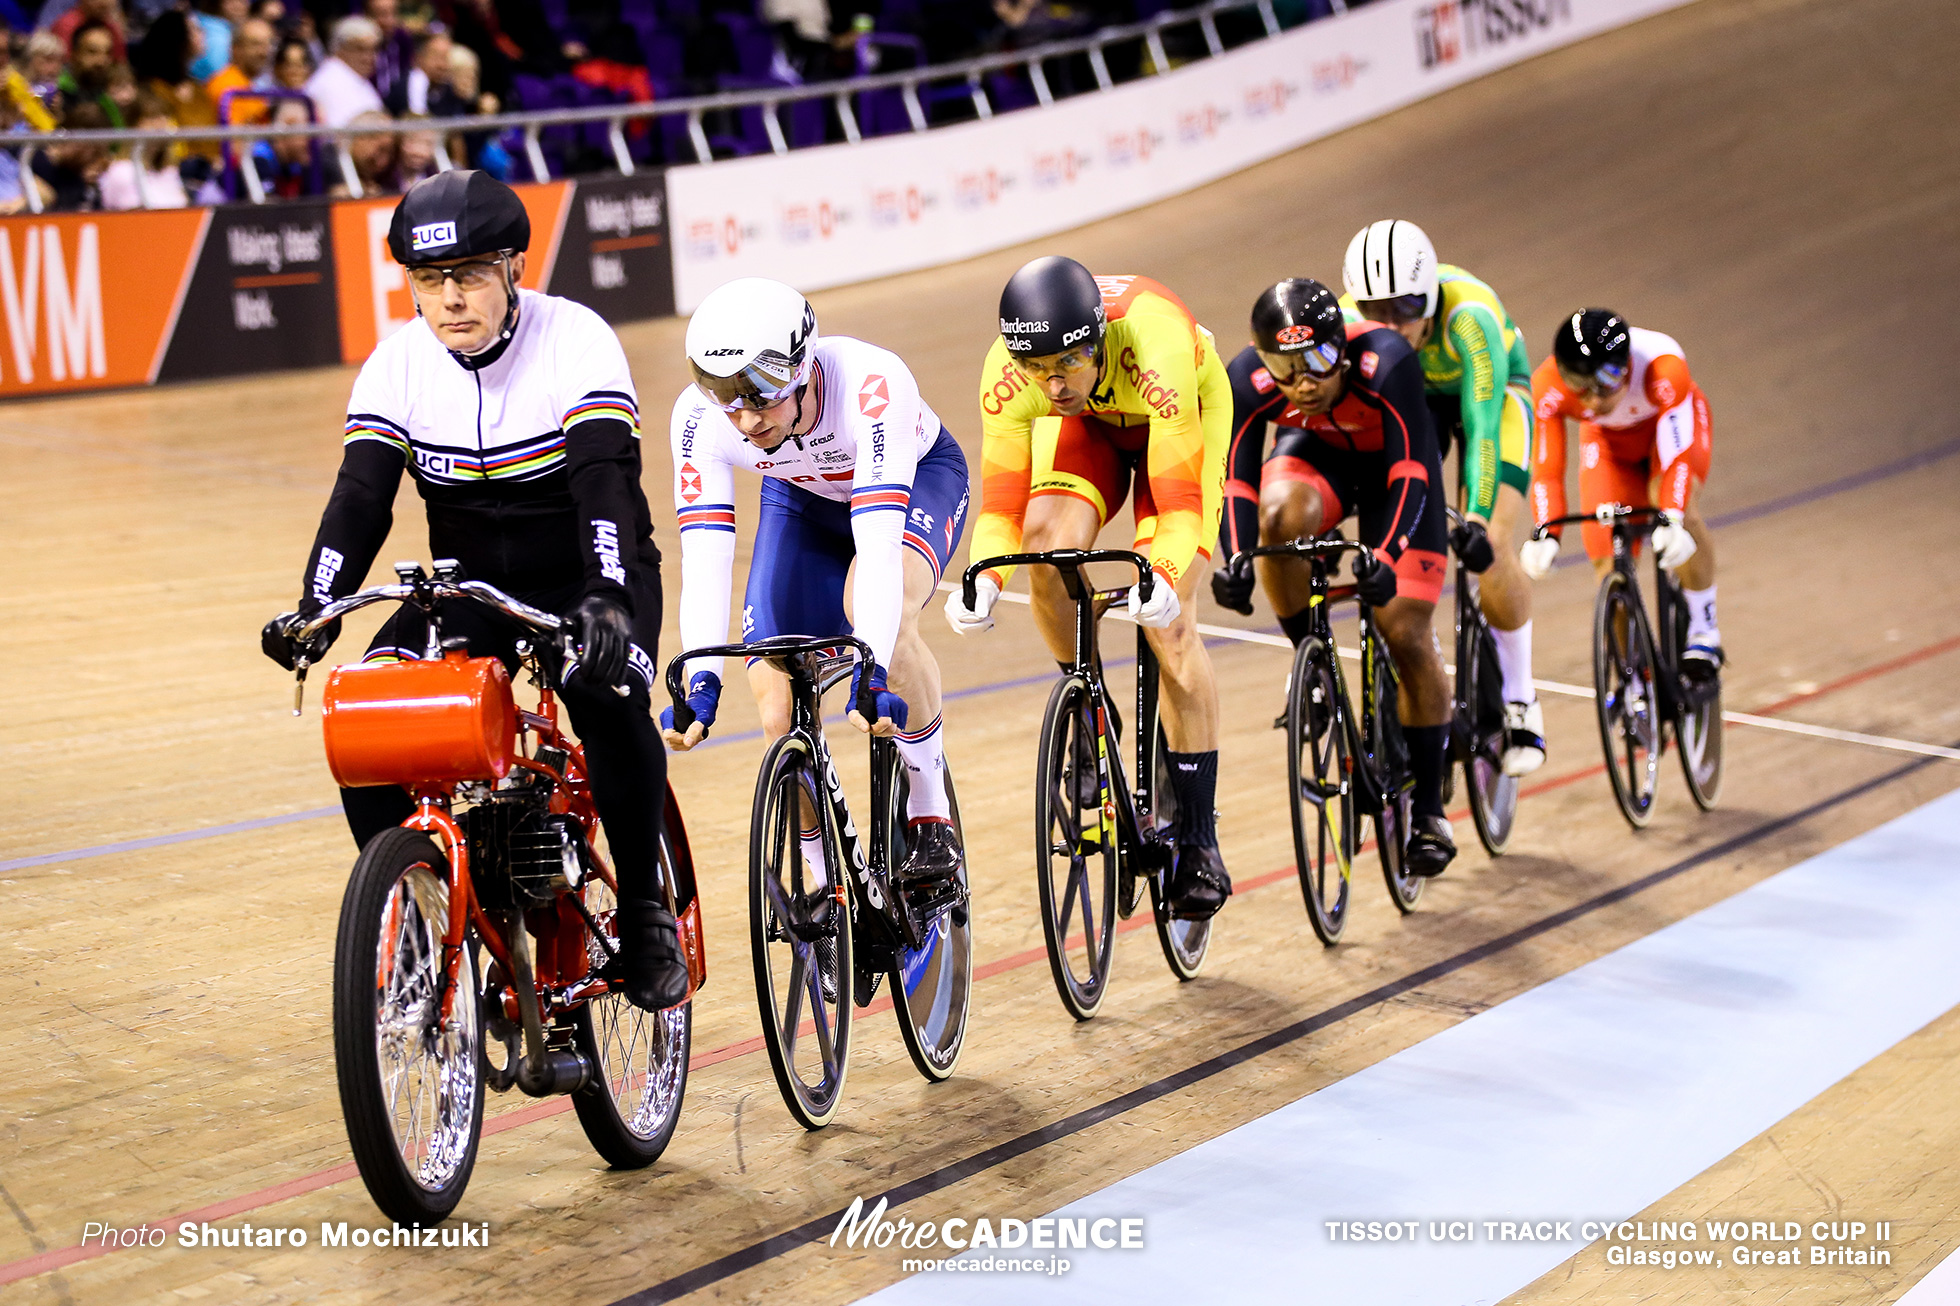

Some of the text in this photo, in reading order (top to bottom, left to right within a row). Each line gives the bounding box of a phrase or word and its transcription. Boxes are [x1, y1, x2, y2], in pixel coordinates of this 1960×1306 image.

[420, 227, 452, 244] UCI
[0, 223, 107, 384] VM
[789, 299, 815, 356] LAZ
[704, 348, 745, 357] LAZER
[982, 362, 1030, 416] Cofi
[1120, 346, 1180, 420] Cofidis
[681, 403, 707, 459] HSBC UK
[870, 421, 885, 484] HSBC UK
[416, 452, 451, 475] UCI
